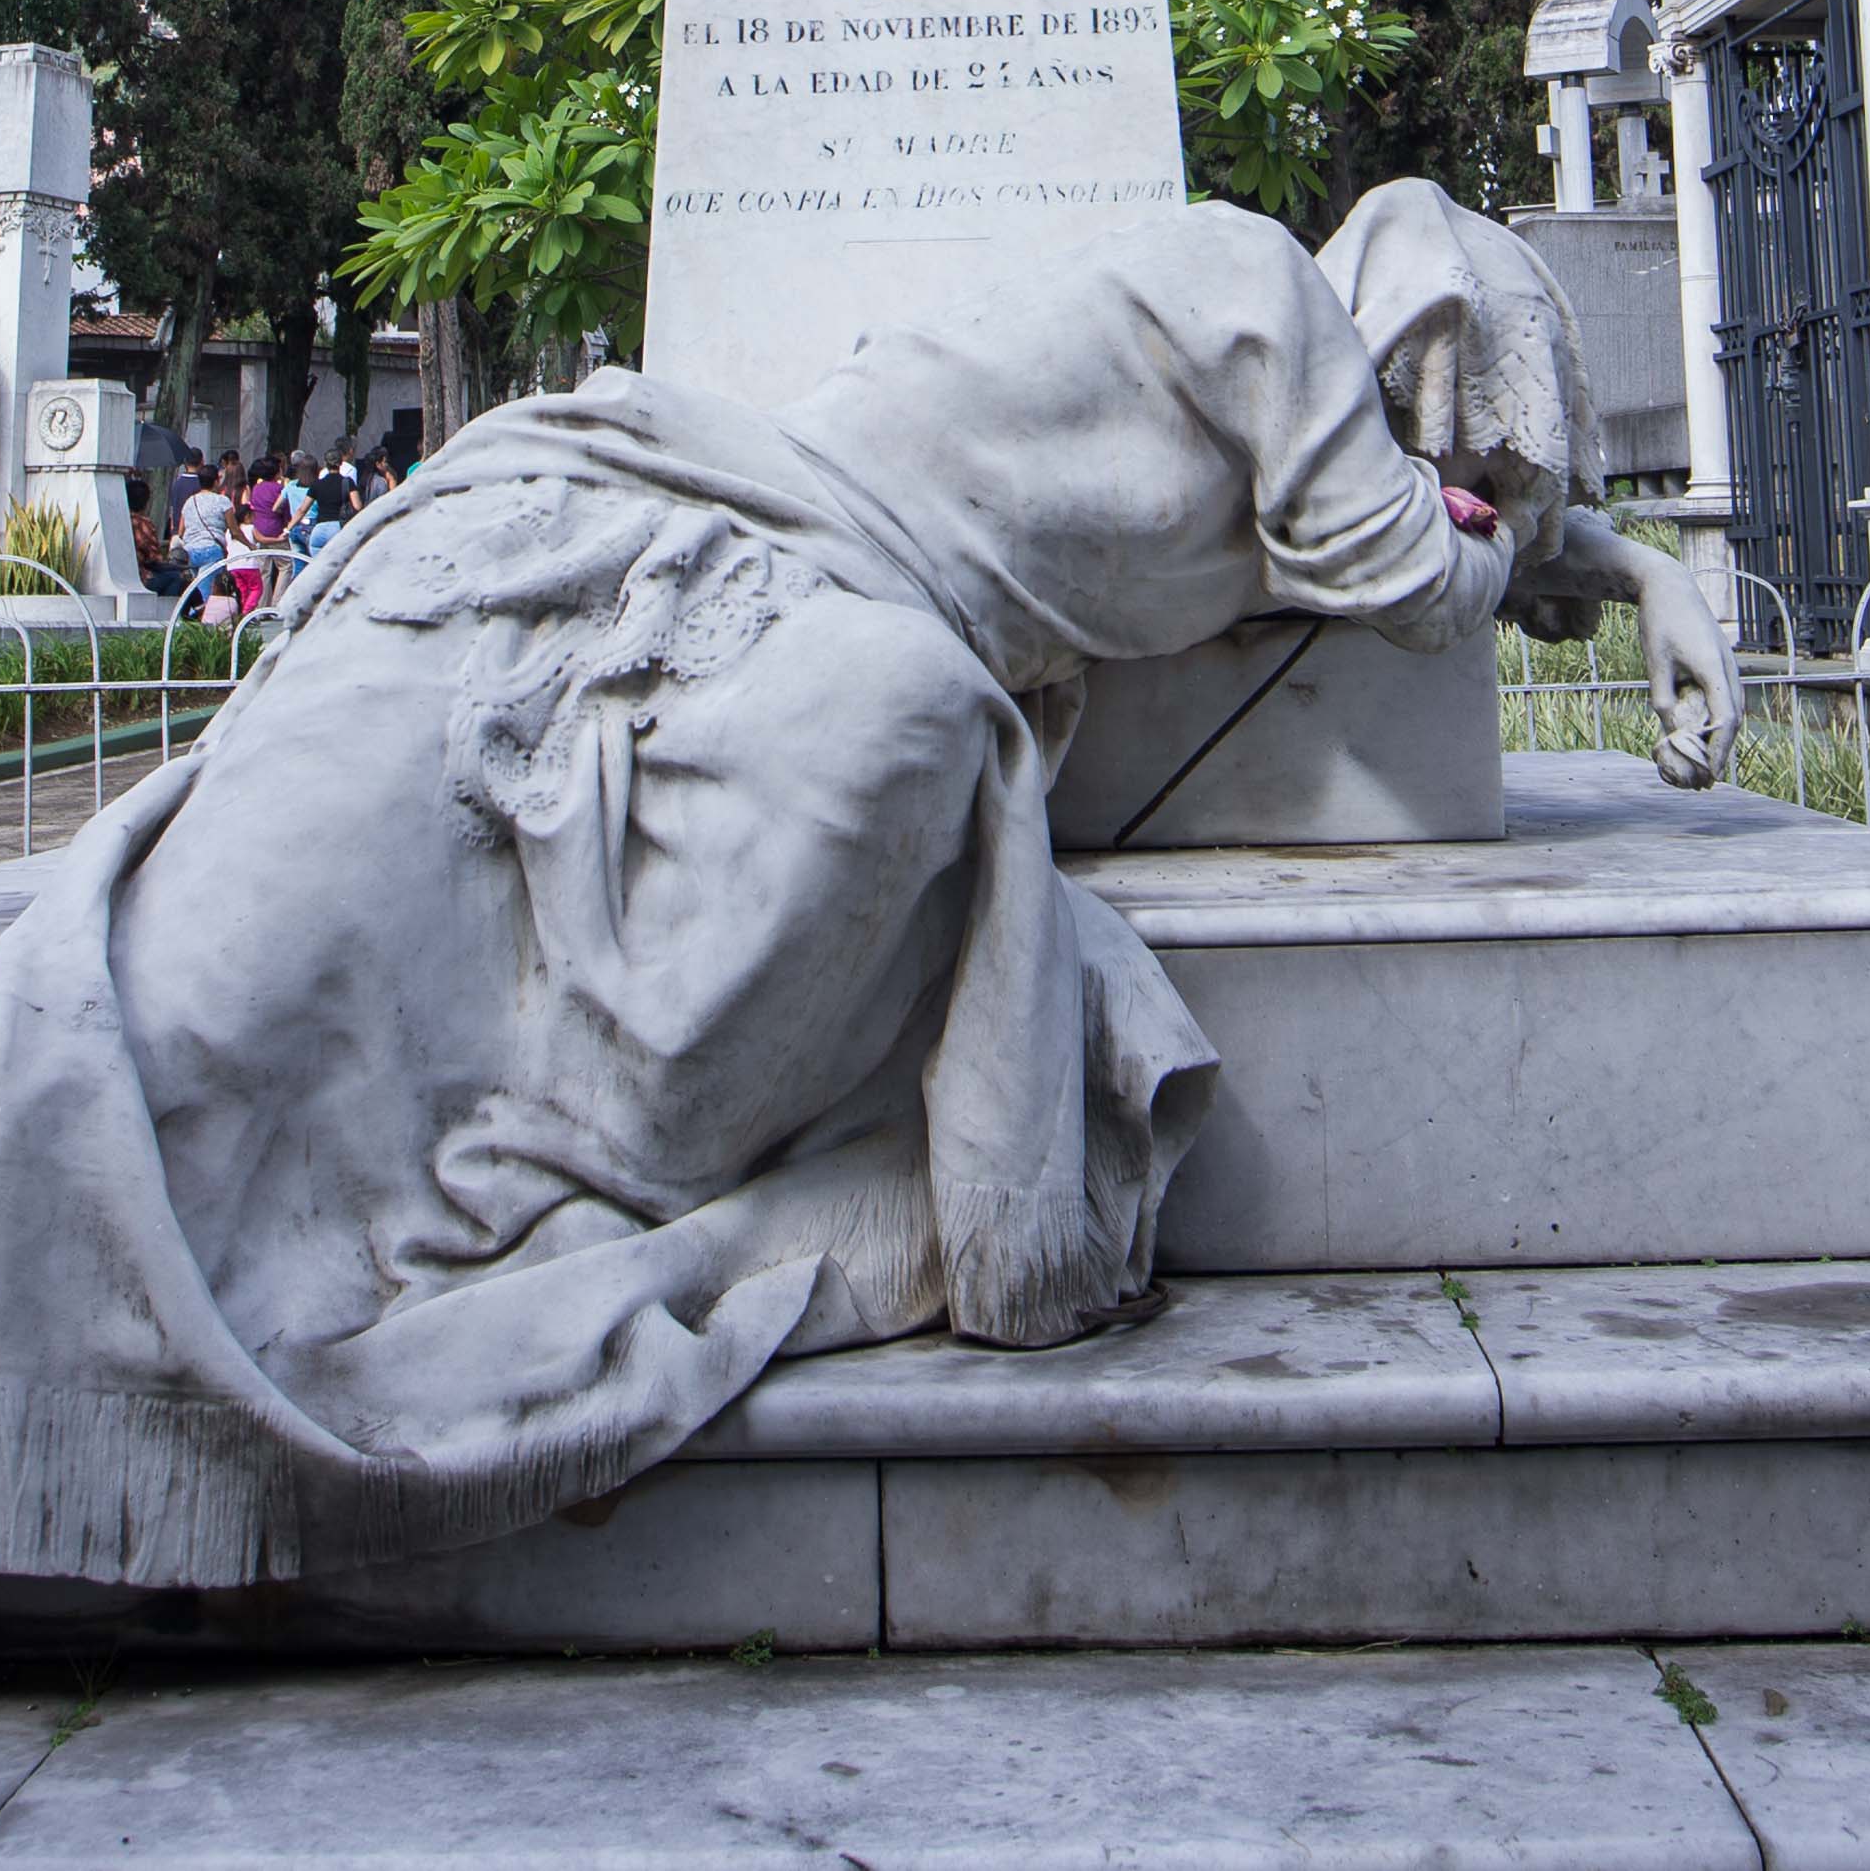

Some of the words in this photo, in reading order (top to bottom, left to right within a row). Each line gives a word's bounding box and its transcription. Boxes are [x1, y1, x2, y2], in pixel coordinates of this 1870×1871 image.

[682, 22, 721, 46] EL
[736, 17, 771, 45] 18
[784, 19, 826, 44] DE
[839, 13, 1025, 42] NOVIEMBRE
[1040, 12, 1079, 36] DE
[716, 74, 738, 97] A
[751, 72, 793, 96] LA
[808, 69, 895, 95] EDAD
[911, 67, 950, 92] DE
[1026, 57, 1115, 89] AÑOS
[892, 132, 1018, 157] MADRE
[664, 191, 725, 217] QUE
[737, 188, 843, 213] CONFIA
[913, 181, 986, 210] DIOS
[995, 179, 1177, 206] CONSOLADOR
